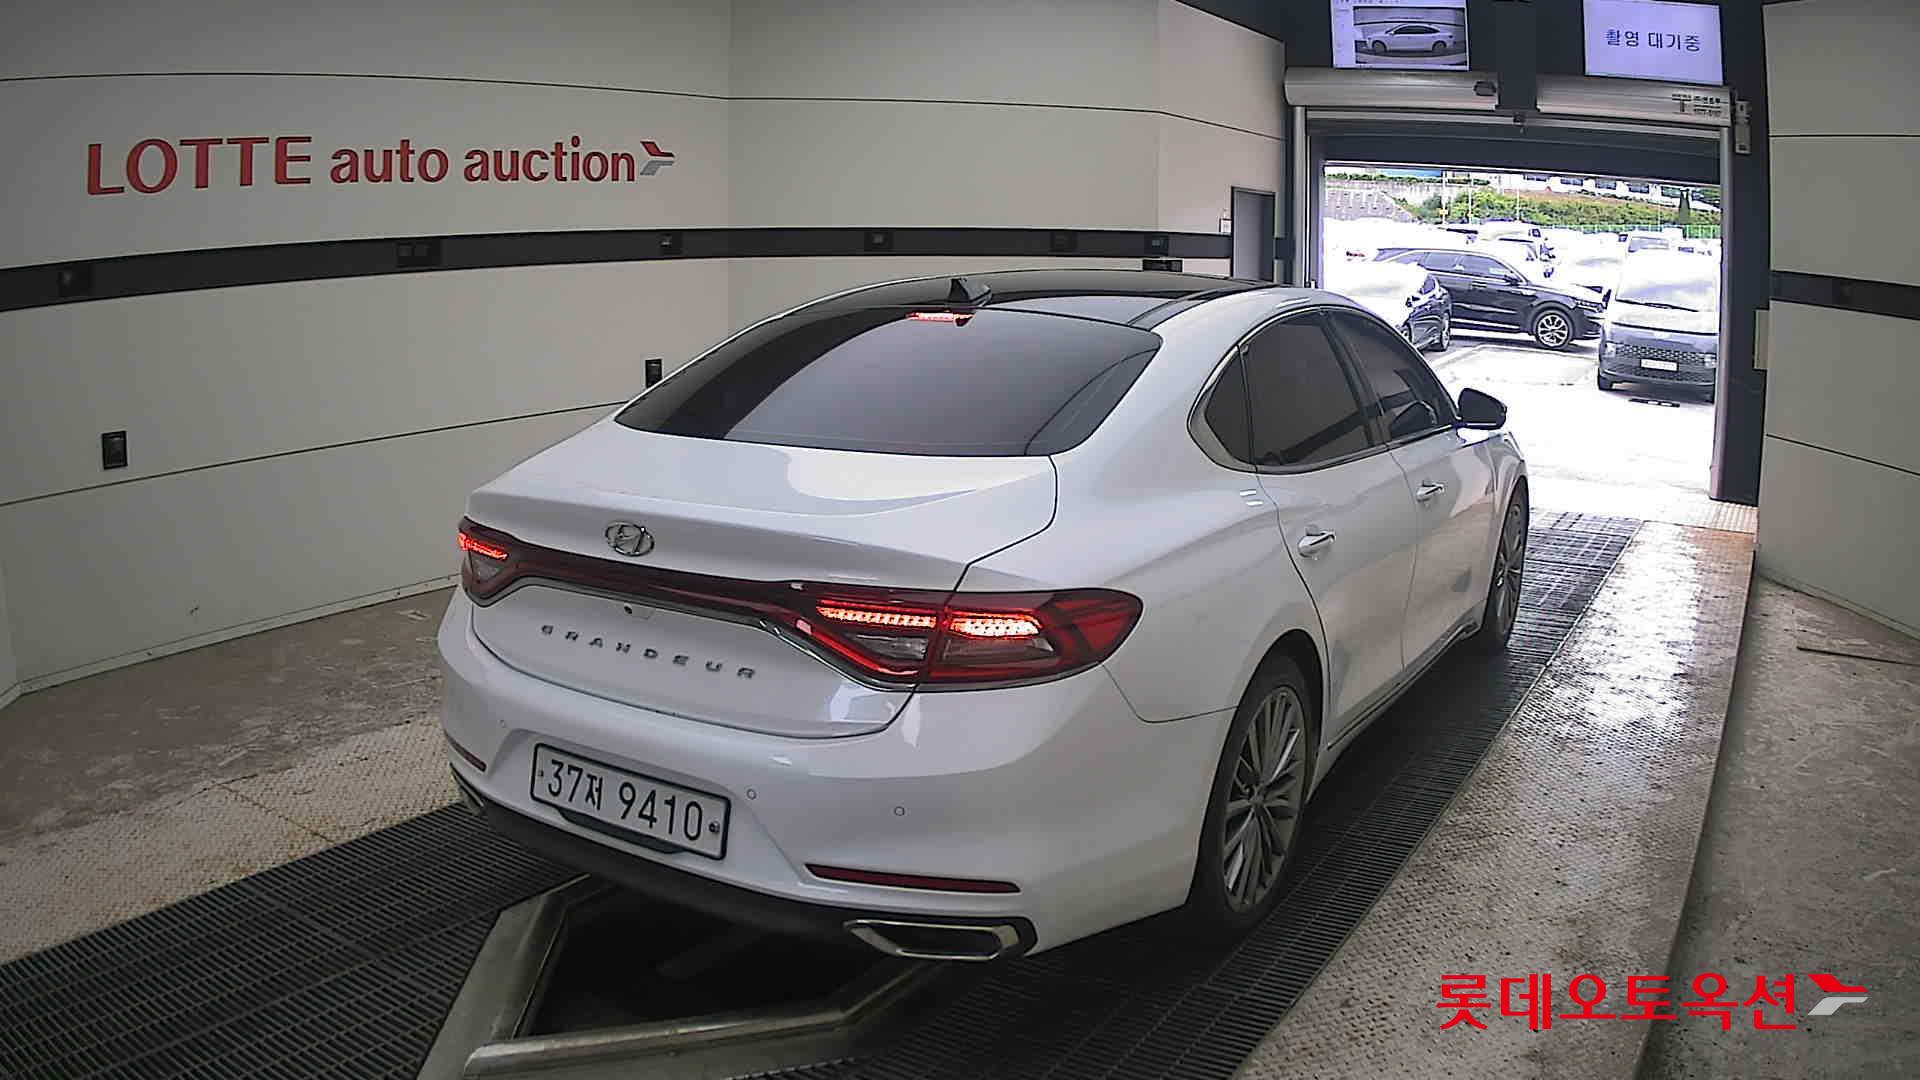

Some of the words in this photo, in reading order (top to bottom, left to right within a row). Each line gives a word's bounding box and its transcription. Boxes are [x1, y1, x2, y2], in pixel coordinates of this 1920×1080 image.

[1605, 28, 1639, 47] 촬영
[1648, 32, 1700, 51] 대기중
[87, 136, 312, 195] LOTTE
[330, 138, 450, 184] auto
[463, 135, 636, 184] auction
[541, 624, 755, 679] GRANDEUR
[548, 759, 603, 811] 37저
[619, 782, 703, 841] 9410
